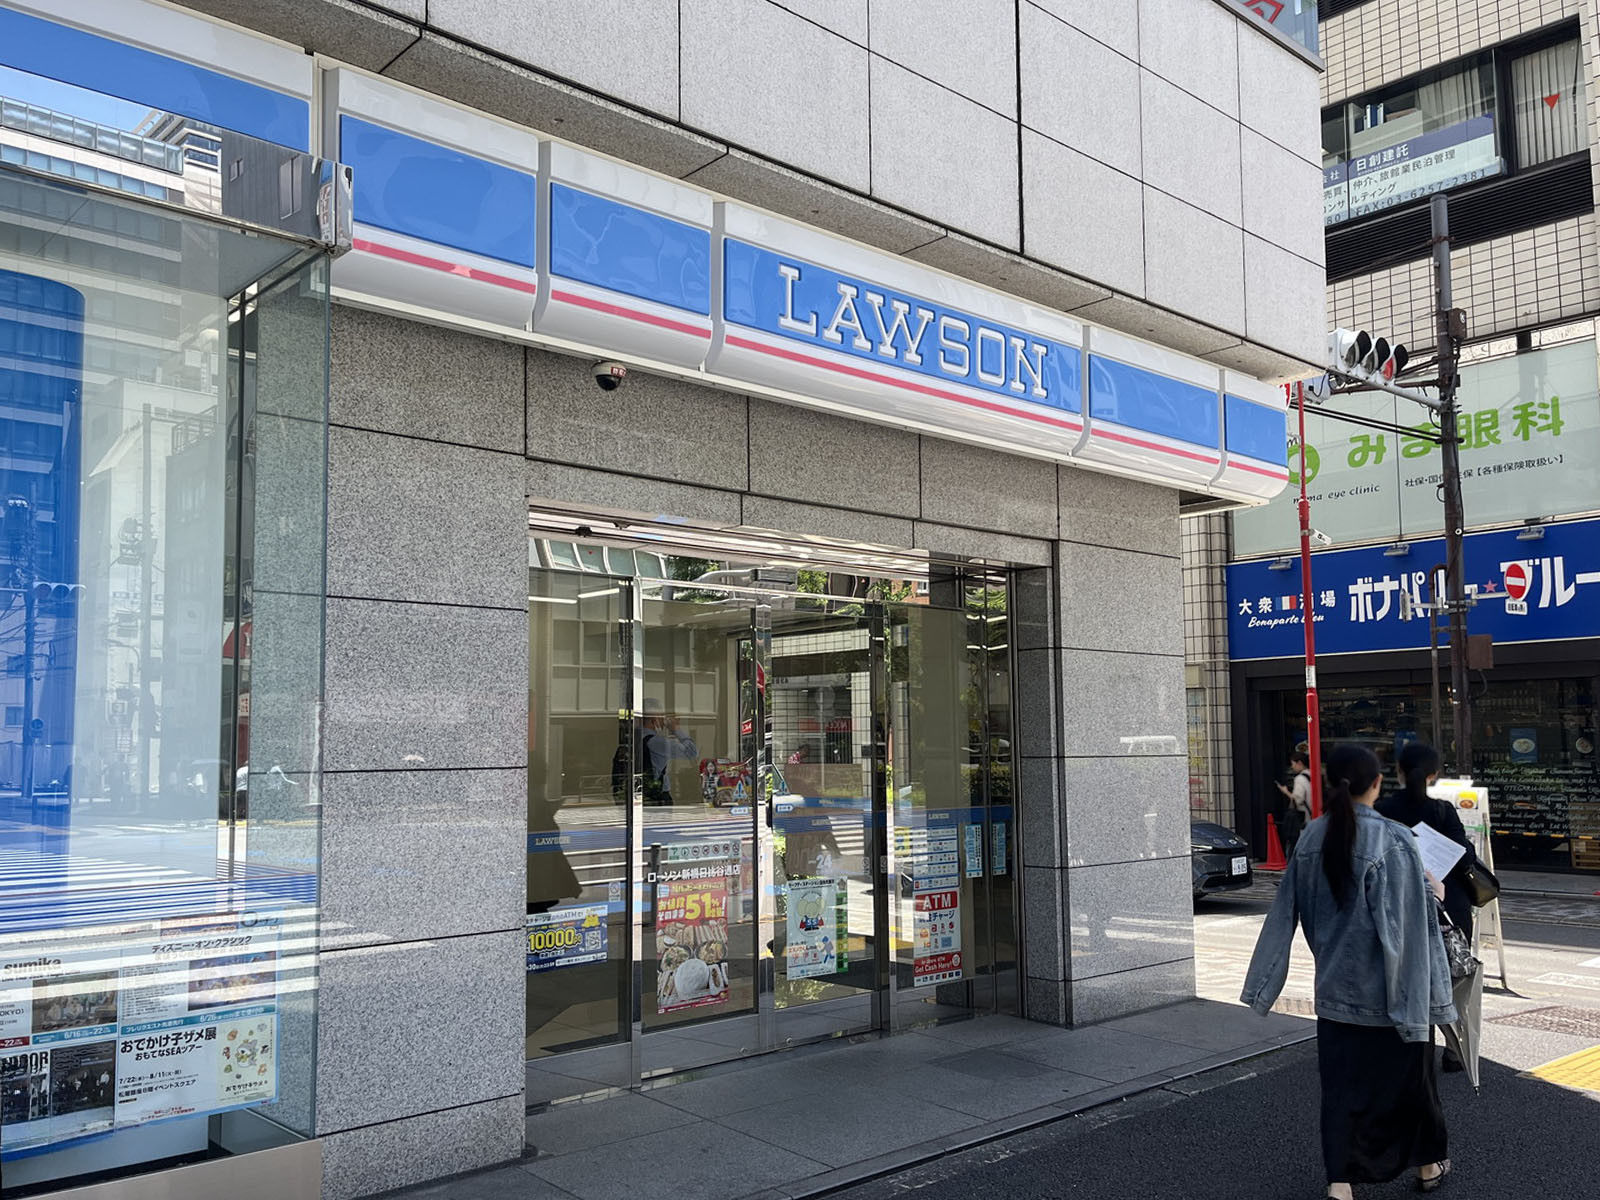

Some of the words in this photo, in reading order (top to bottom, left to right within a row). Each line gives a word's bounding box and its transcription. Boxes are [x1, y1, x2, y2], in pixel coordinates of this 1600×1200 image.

[1356, 143, 1409, 171] 日創建託
[778, 262, 1048, 399] LAWSON
[1328, 490, 1346, 500] eye
[1349, 485, 1381, 496] clinic
[1239, 597, 1273, 616] 大衆
[1248, 615, 1300, 629] Bonaparte
[648, 864, 740, 883] ローソン新橋日比谷通店
[923, 893, 951, 910] ATM
[152, 936, 252, 953] ディズニー・オン・クラシック
[4, 957, 62, 975] sumika
[121, 1027, 216, 1053] おでかけ子ザメ展
[135, 1044, 203, 1061] おもてなSEAツアー
